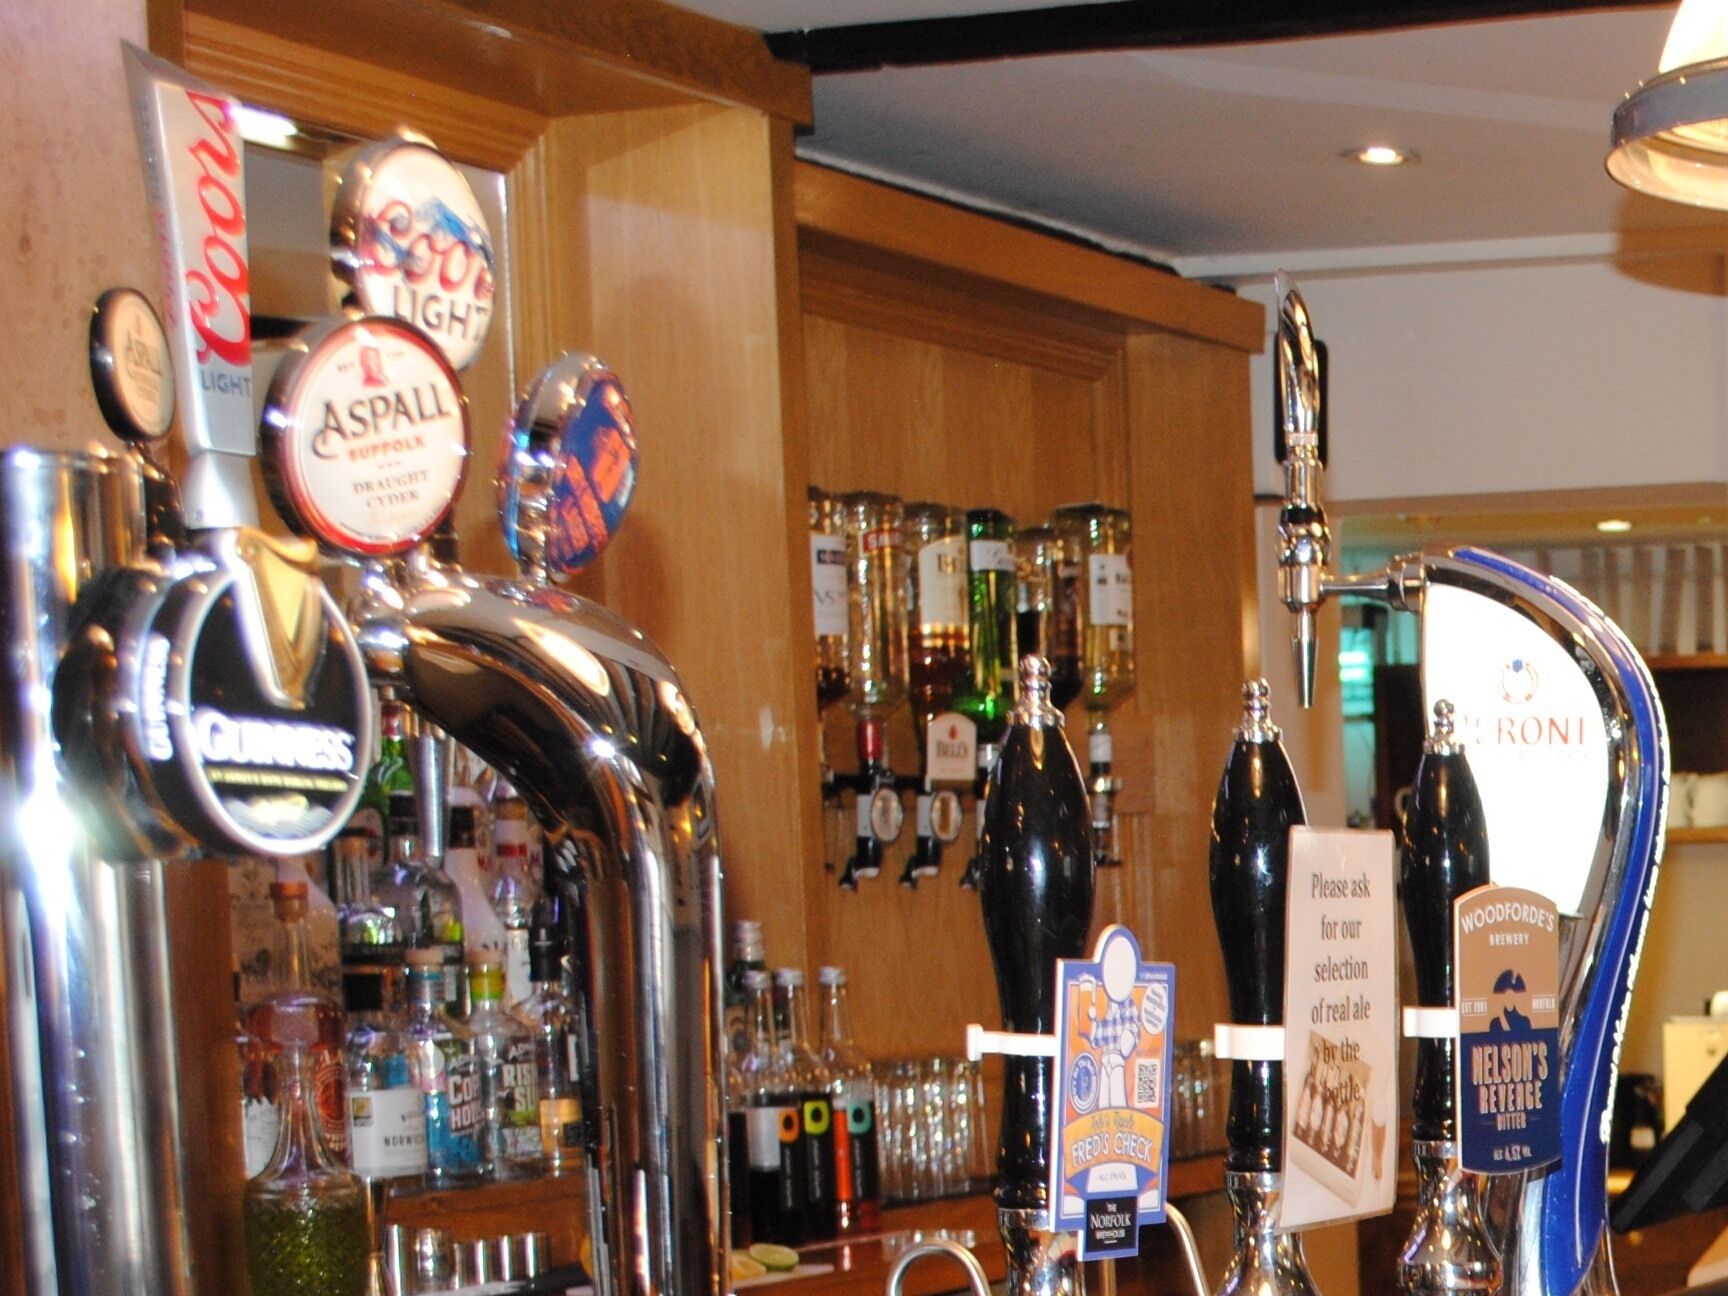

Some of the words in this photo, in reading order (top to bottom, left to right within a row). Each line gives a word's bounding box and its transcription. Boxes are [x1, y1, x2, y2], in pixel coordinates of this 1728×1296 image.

[186, 89, 251, 366] Coors
[393, 284, 489, 343] LIGHT
[201, 368, 252, 397] LIGHT
[312, 384, 452, 460] ASPALL
[348, 434, 427, 463] SUFFOLK
[353, 469, 430, 496] DRAUGHT
[367, 493, 420, 512] CYDER
[196, 709, 356, 772] GUINNESS
[1462, 716, 1586, 745] RONI
[1311, 872, 1349, 899] Please
[1351, 872, 1371, 899] ask
[1321, 914, 1338, 941] for
[1341, 921, 1362, 939] our
[1461, 902, 1555, 934] WOODFORDE'S
[1489, 933, 1530, 946] BREWERY
[1314, 956, 1369, 983] selection
[1311, 998, 1325, 1025] of
[1326, 995, 1350, 1023] real
[1353, 994, 1371, 1020] ale
[1322, 1040, 1339, 1071] by
[1341, 1037, 1361, 1063] the
[1471, 1041, 1548, 1086] NELSON'S
[1323, 1074, 1361, 1106] bottle
[1478, 1081, 1543, 1114] REVENGE
[1496, 1113, 1526, 1131] BITTER
[1071, 1133, 1110, 1167] FRED'S
[1113, 1132, 1153, 1163] CHECK
[1089, 1213, 1132, 1230] NORFOLK
